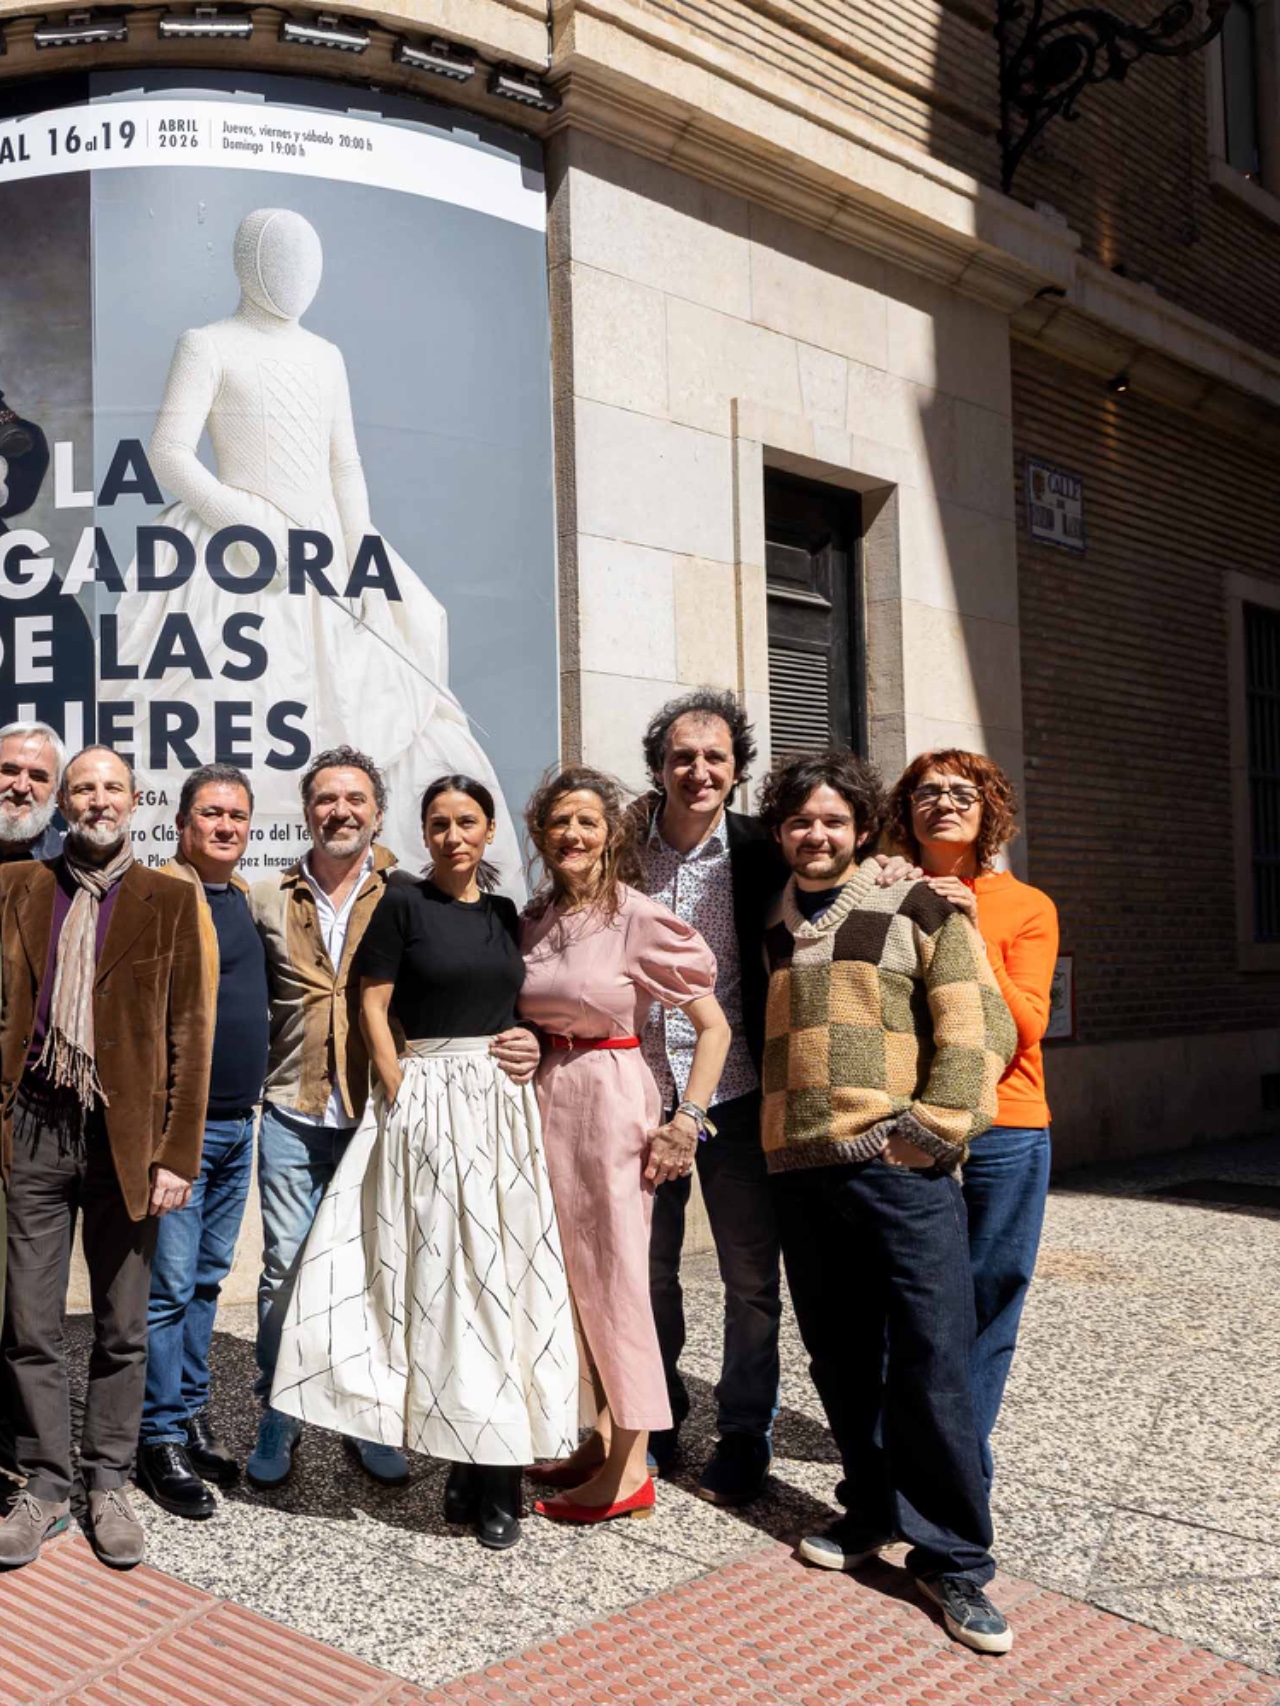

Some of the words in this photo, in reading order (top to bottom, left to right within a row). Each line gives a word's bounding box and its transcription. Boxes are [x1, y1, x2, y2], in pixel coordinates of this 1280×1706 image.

[158, 119, 198, 132] ABRIL
[158, 135, 199, 148] 2026
[222, 120, 256, 136] Jueves,
[259, 124, 292, 140] viernes
[294, 131, 301, 142] y
[302, 131, 334, 145] sábado
[339, 134, 365, 149] 20:00
[366, 138, 373, 151] h
[222, 136, 264, 153] Domingo
[270, 140, 298, 156] 19:00
[299, 144, 306, 157] h
[53, 438, 164, 509] LA
[100, 612, 269, 681] LAS
[138, 790, 169, 806] EGA
[269, 823, 290, 841] del
